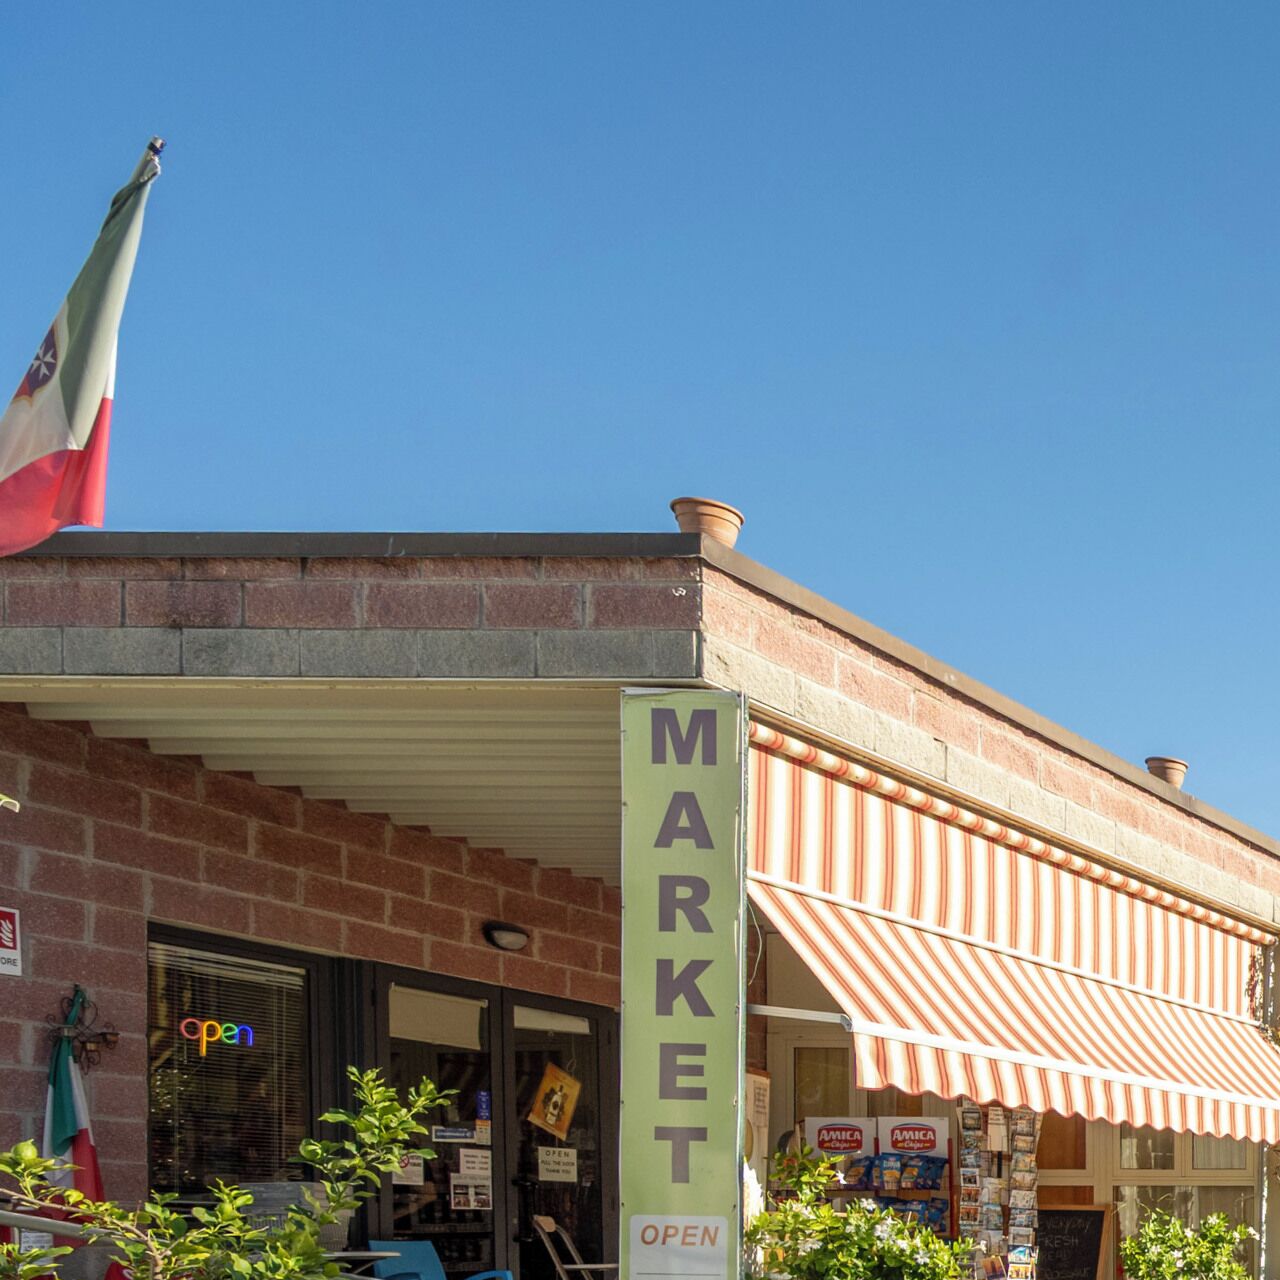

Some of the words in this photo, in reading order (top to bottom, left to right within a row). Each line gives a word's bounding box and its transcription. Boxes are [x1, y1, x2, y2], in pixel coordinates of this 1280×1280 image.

[650, 707, 718, 1184] MARKET
[180, 1018, 253, 1057] open
[820, 1129, 861, 1141] AMICA
[892, 1129, 935, 1141] AMICA
[545, 1150, 570, 1158] OPEN
[640, 1224, 719, 1247] OPEN
